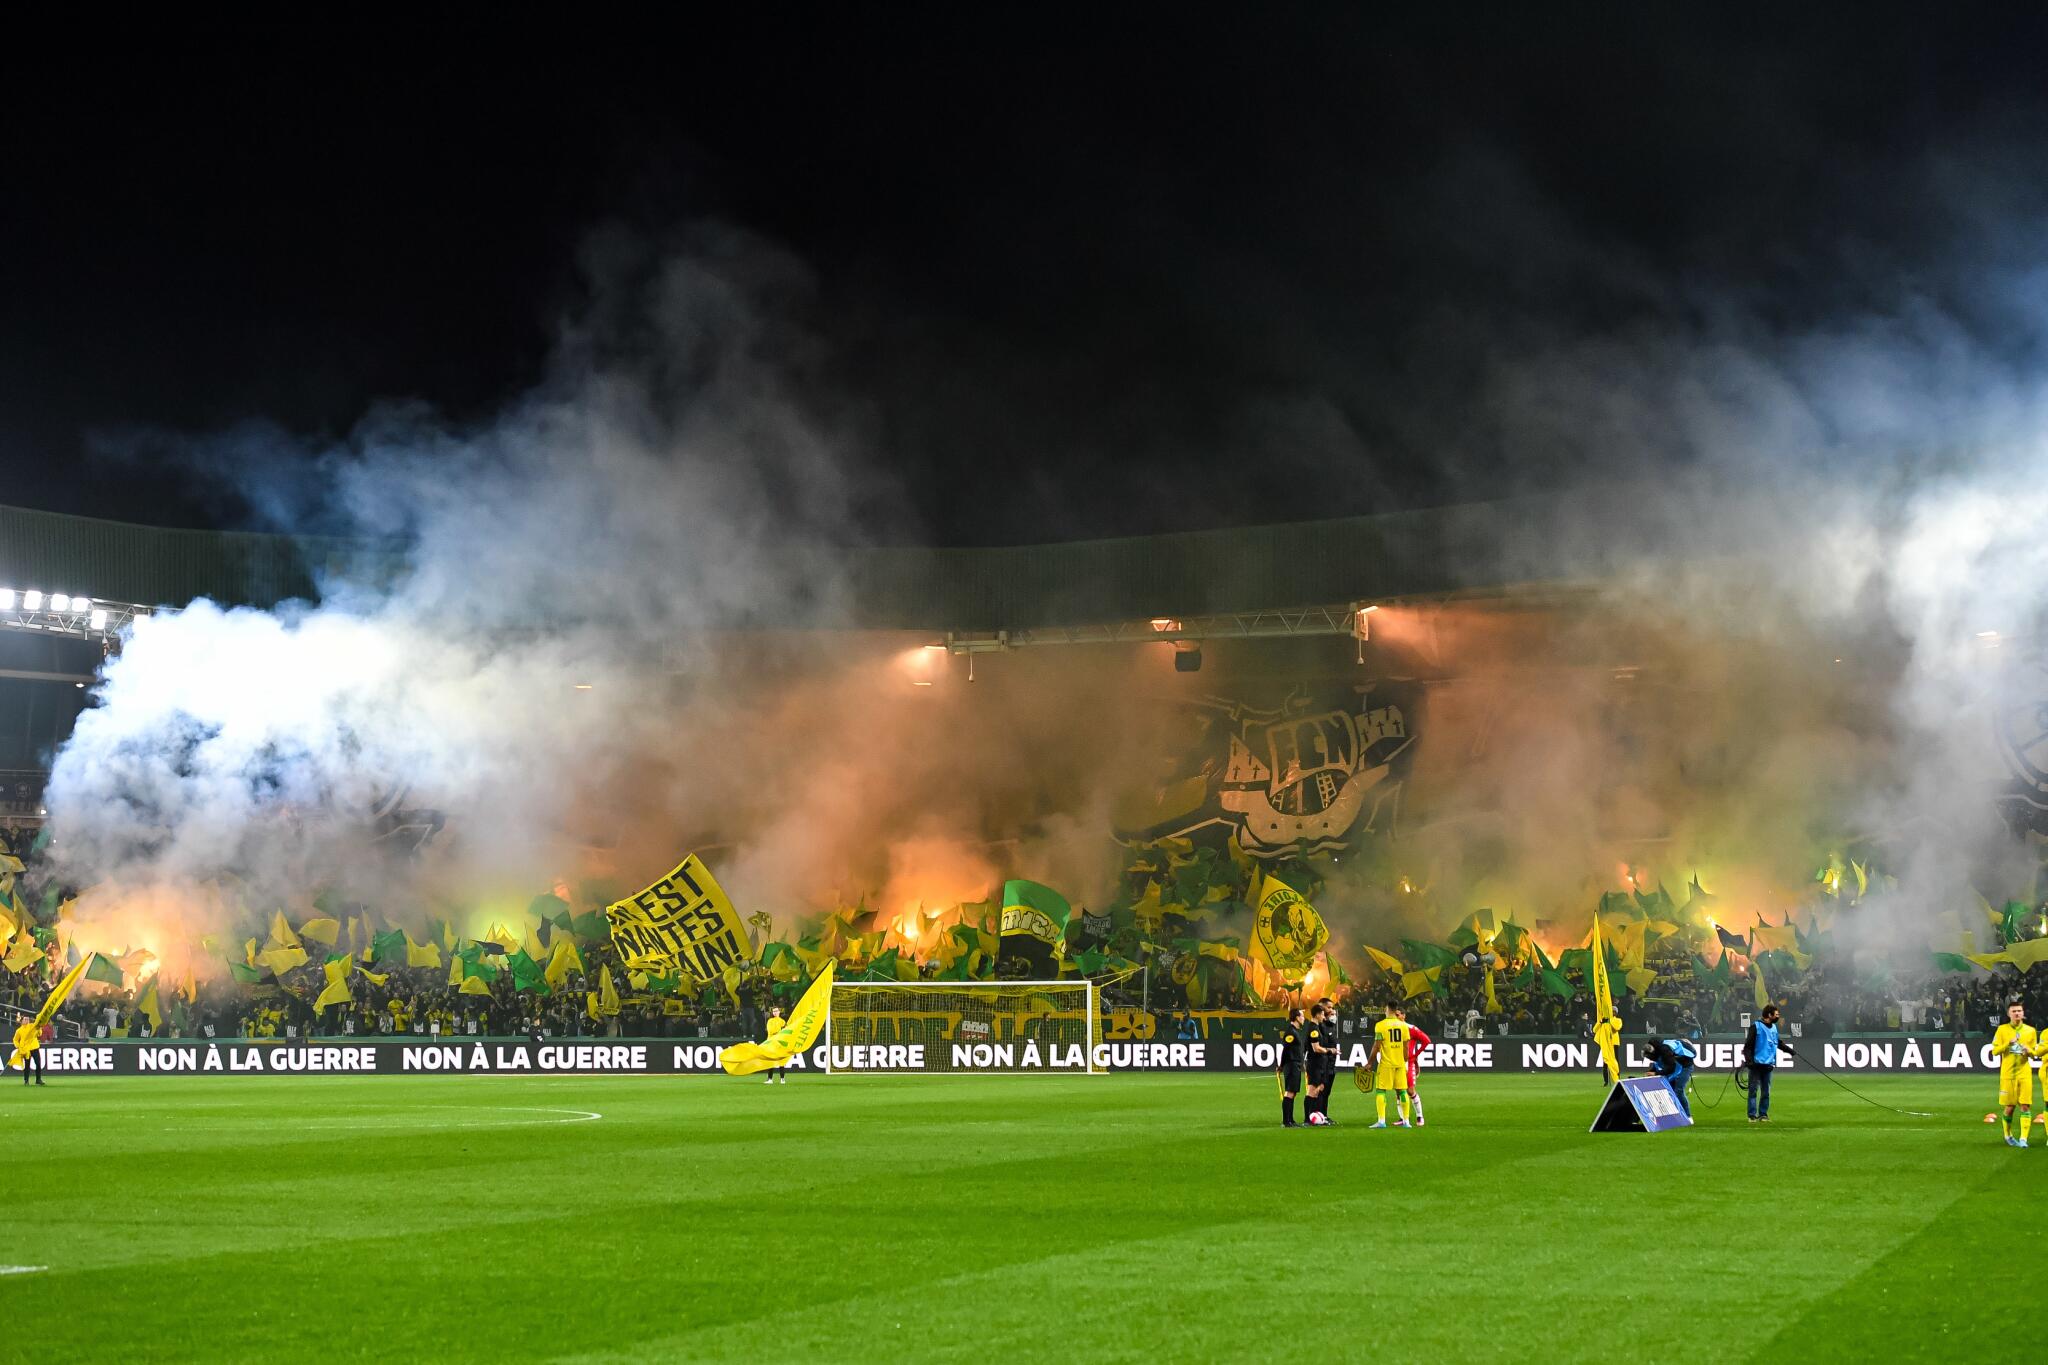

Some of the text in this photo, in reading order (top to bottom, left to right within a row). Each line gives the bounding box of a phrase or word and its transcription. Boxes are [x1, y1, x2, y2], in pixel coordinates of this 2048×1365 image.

[634, 862, 704, 923] EST
[613, 898, 725, 961] NANTES
[1387, 1027, 1403, 1043] 10
[138, 1043, 377, 1071] NON À LA GUERRE
[402, 1041, 647, 1070] NON À LA GUERRE
[812, 1045, 925, 1069] GUERRE
[952, 1038, 1206, 1068] NON À LA GUERRE
[1334, 1043, 1369, 1067] LA
[1522, 1043, 1588, 1068] NON
[1824, 1043, 1893, 1068] NON
[1900, 1037, 1925, 1068] À
[1932, 1043, 1973, 1068] LA
